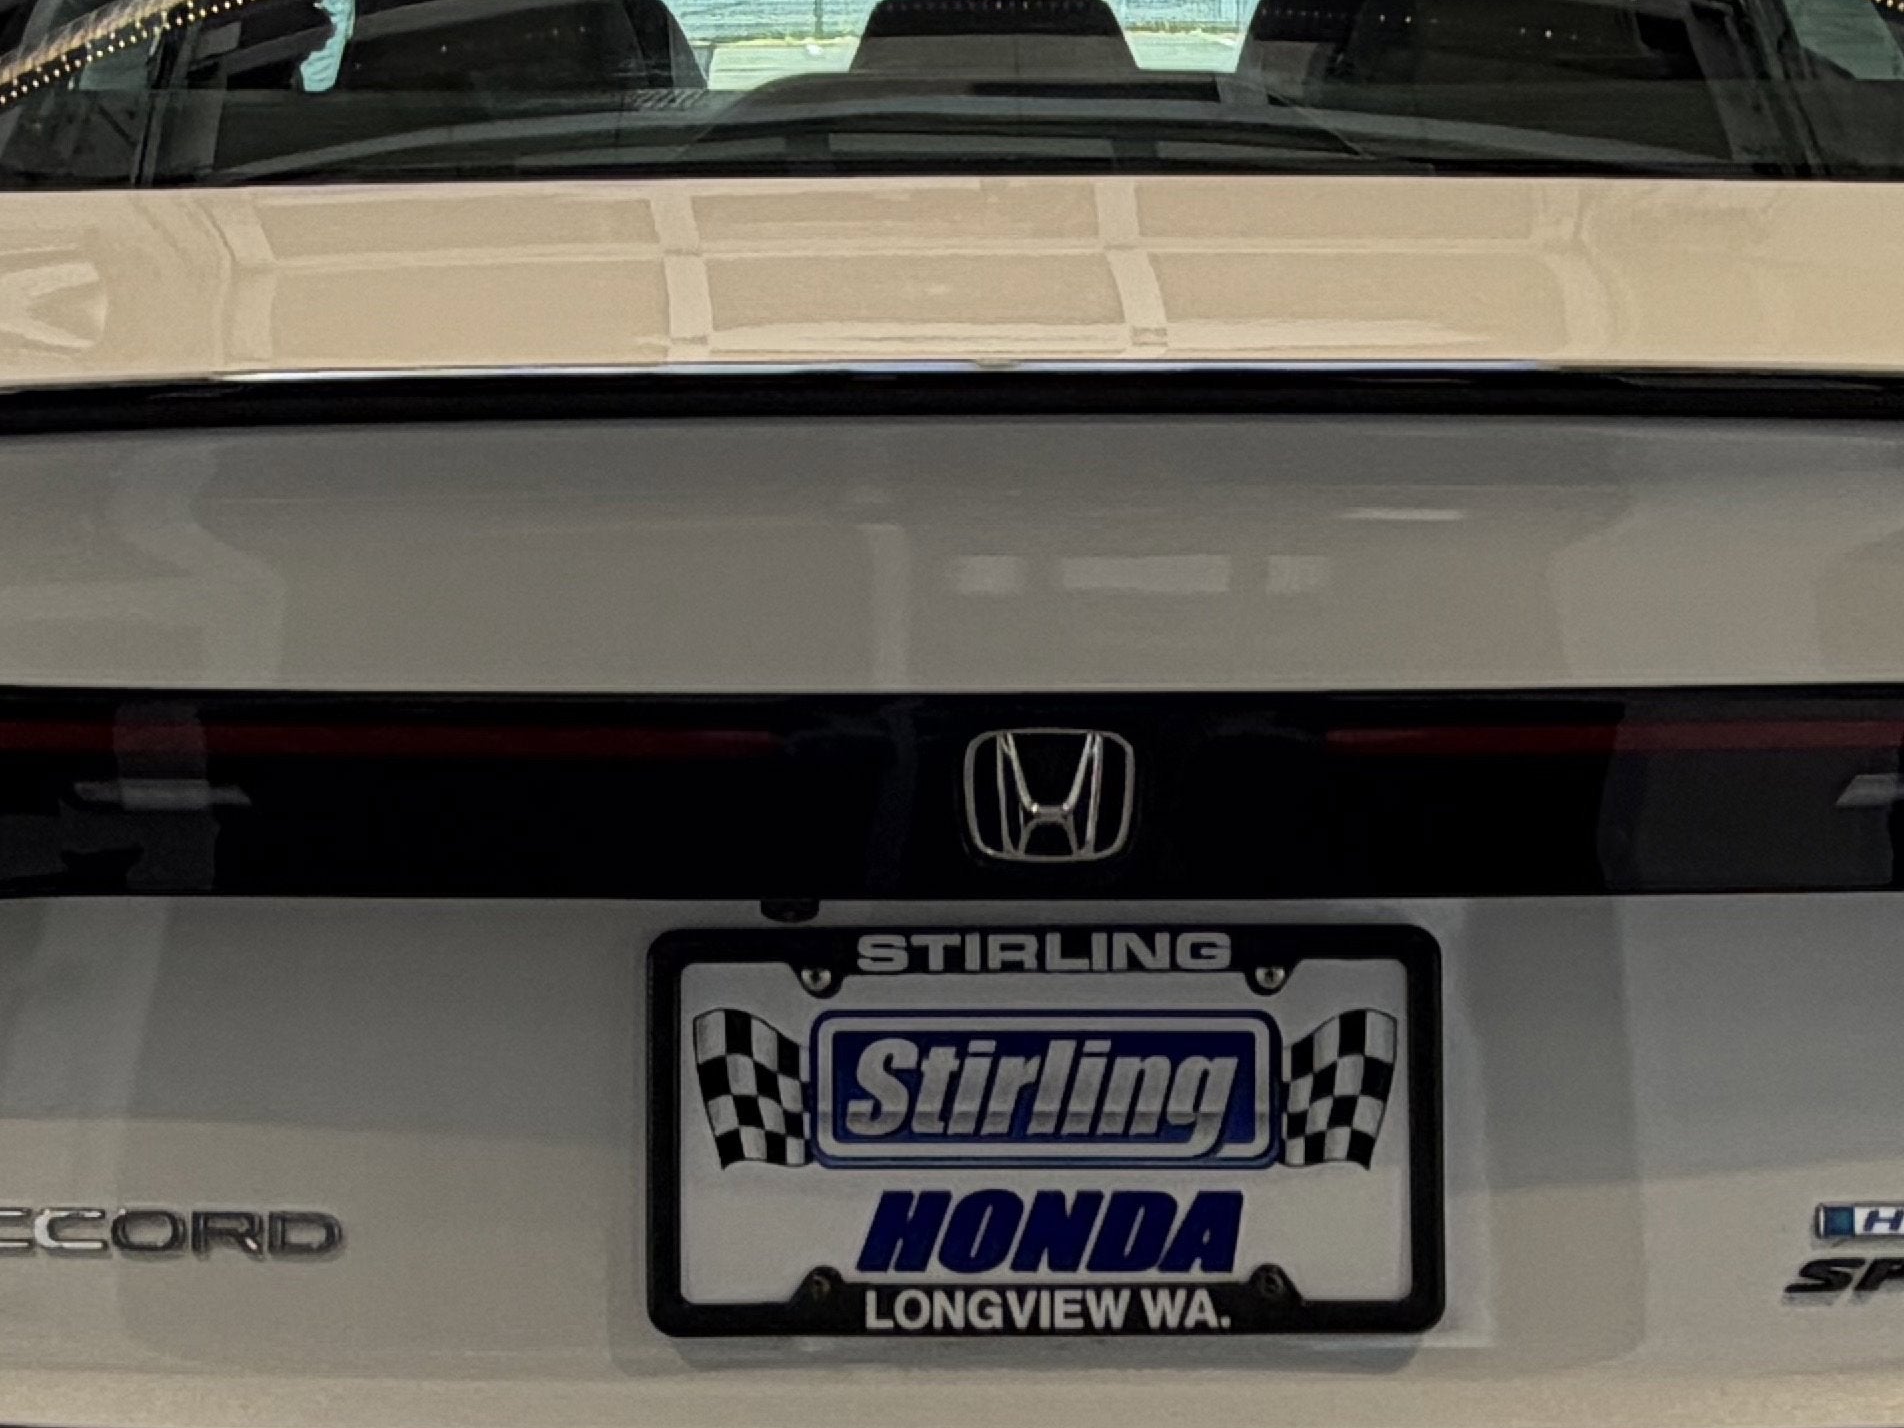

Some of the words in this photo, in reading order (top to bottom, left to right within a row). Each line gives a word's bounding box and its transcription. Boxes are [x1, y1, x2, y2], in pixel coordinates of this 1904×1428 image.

[857, 932, 1232, 972] STIRLING
[846, 1038, 1238, 1158] Stirling
[856, 1188, 1244, 1273] HONDA
[865, 1288, 1131, 1330] LONGVIEW
[1140, 1288, 1231, 1330] WA.
